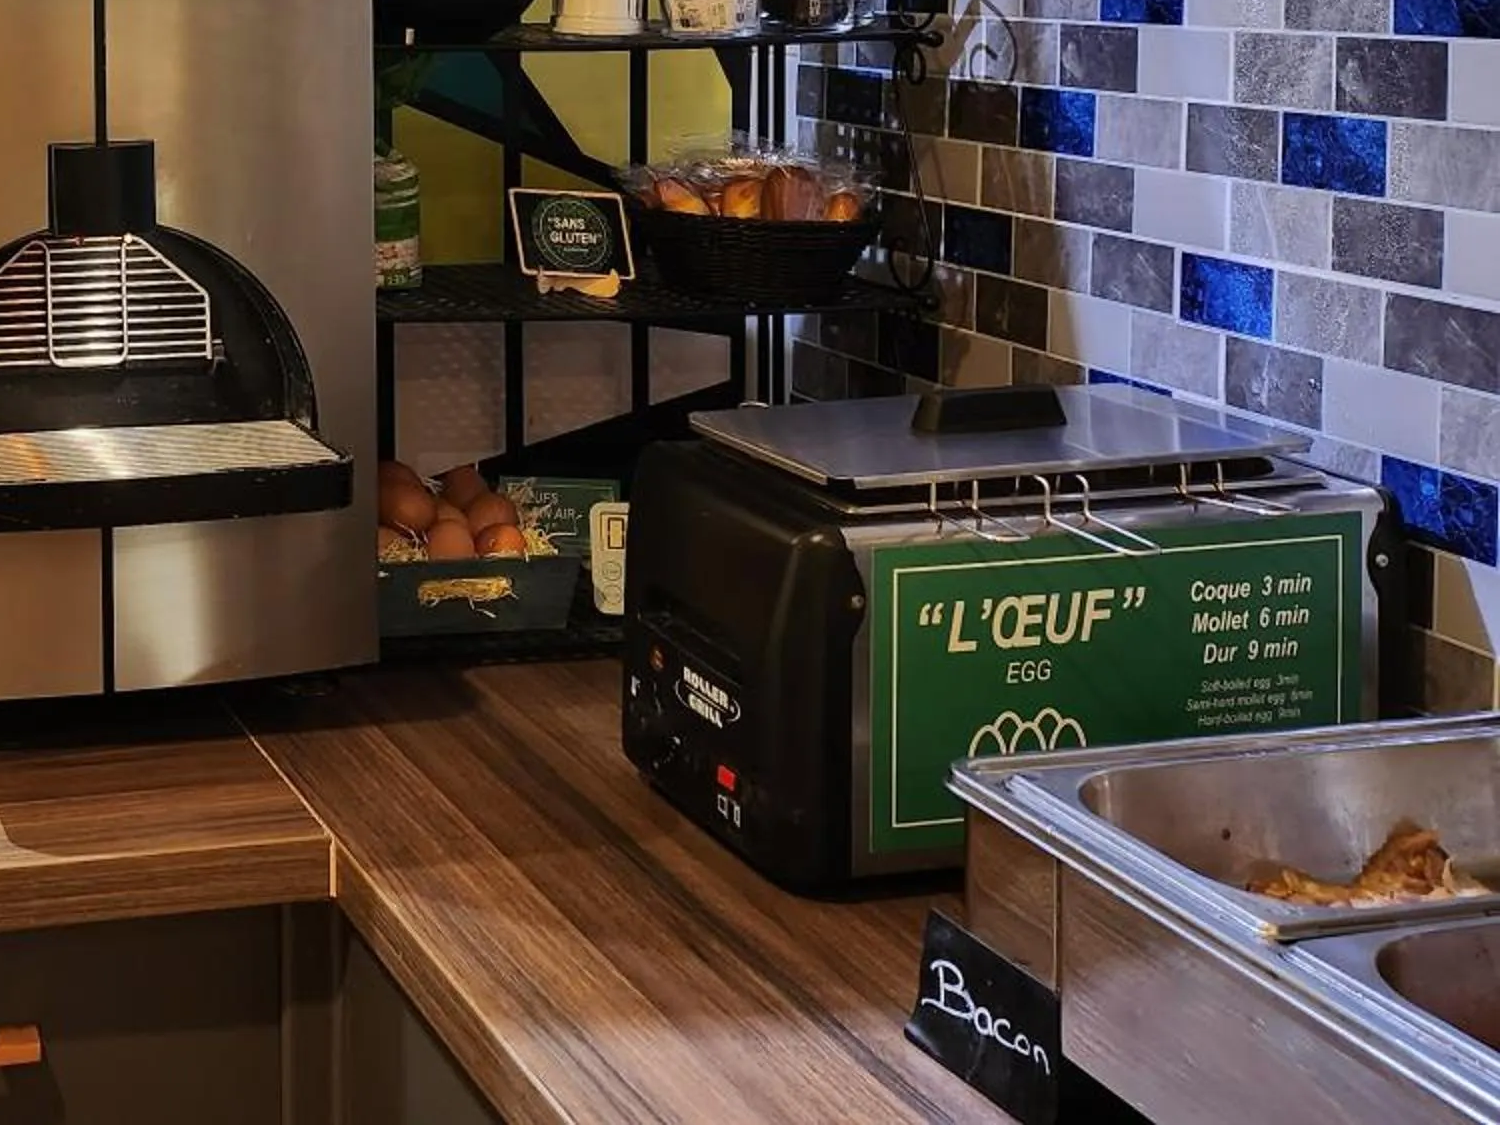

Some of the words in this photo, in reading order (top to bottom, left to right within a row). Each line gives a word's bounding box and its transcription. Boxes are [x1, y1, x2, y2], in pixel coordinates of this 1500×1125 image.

[1191, 580, 1251, 604] Coque
[1261, 575, 1273, 596] 3
[1277, 573, 1312, 595] min
[1191, 610, 1250, 634] Mollet
[1259, 606, 1271, 628] 6
[1275, 604, 1310, 626] min
[1203, 642, 1239, 665] Dur
[1247, 639, 1260, 660] 9
[1263, 636, 1299, 658] min
[1006, 659, 1052, 684] EGG
[683, 666, 729, 710] ROLLER
[688, 693, 723, 729] GRILL
[921, 959, 1051, 1075] Bacon
